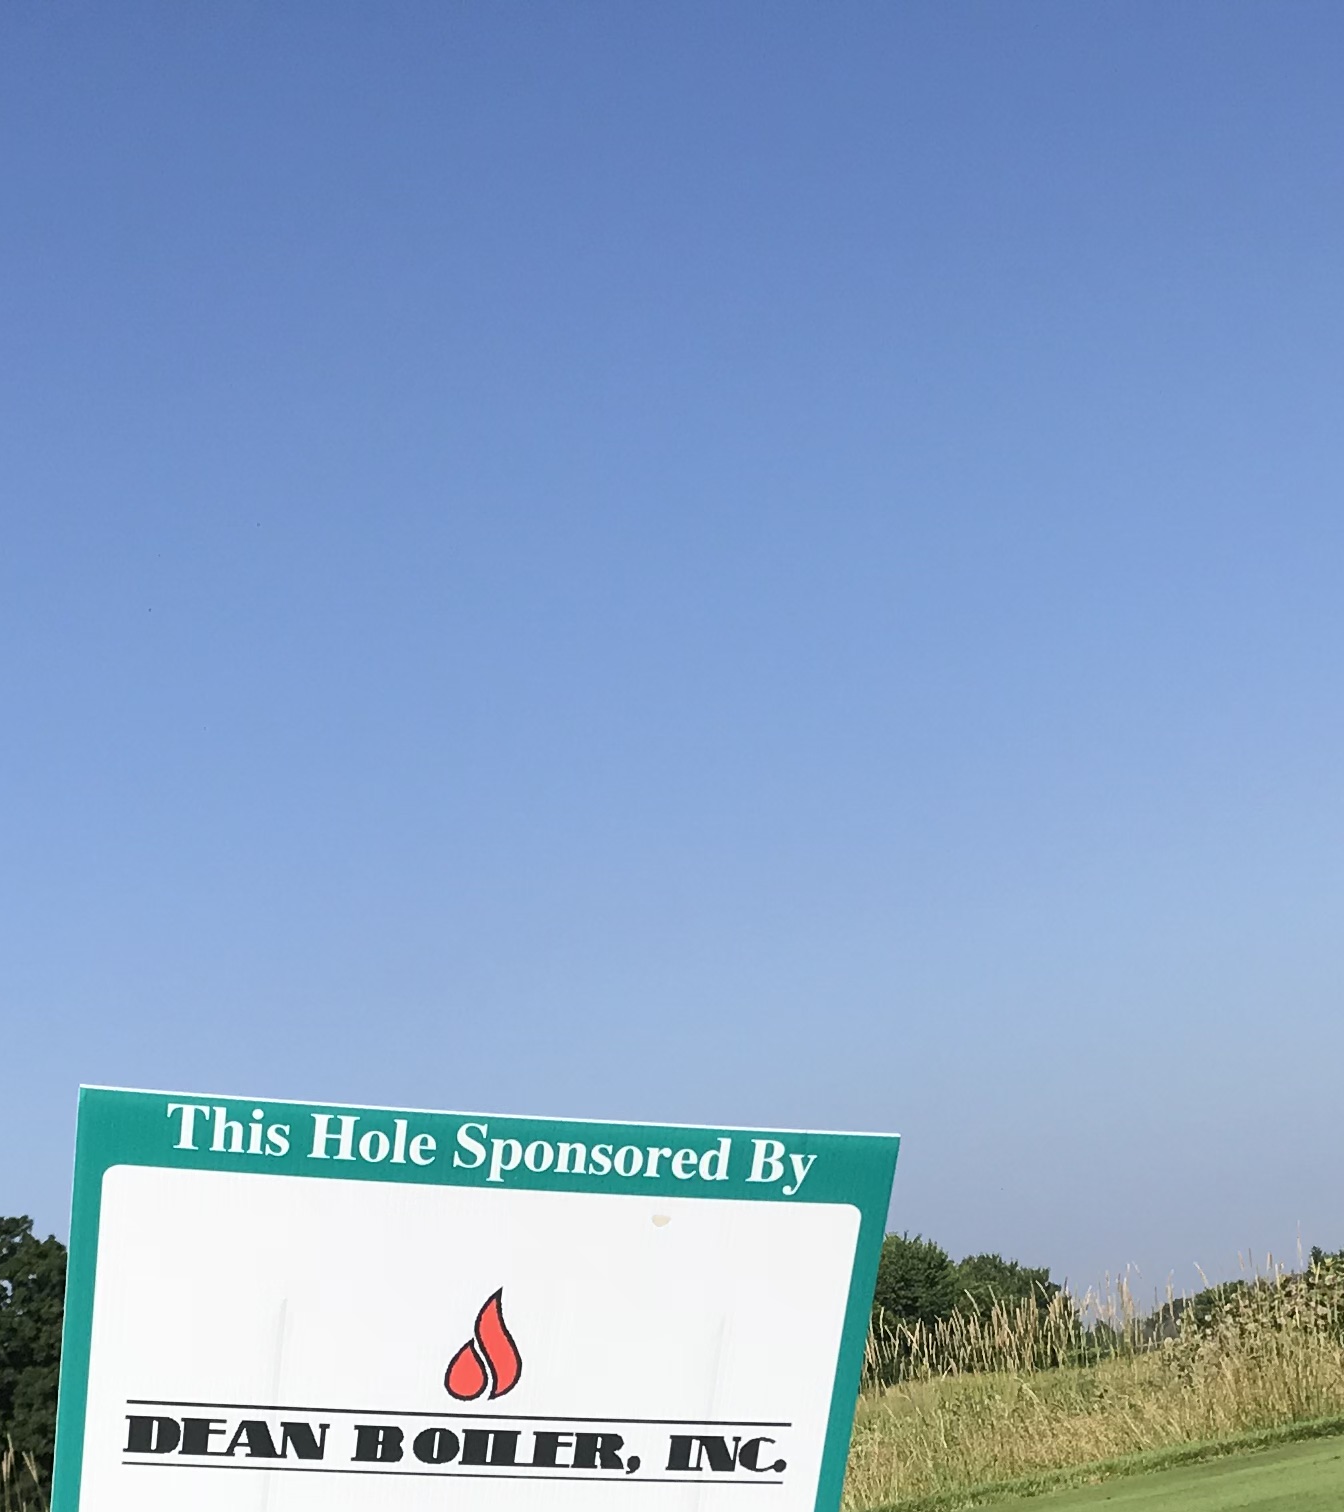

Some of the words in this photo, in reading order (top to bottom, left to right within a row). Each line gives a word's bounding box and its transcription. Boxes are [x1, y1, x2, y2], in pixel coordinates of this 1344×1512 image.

[166, 1102, 291, 1157] This
[306, 1113, 438, 1166] Hole
[452, 1122, 732, 1182] Sponsored
[745, 1138, 818, 1196] By
[122, 1414, 331, 1461] DEAN
[350, 1424, 641, 1475] BOILER,
[664, 1434, 788, 1473] INC.
